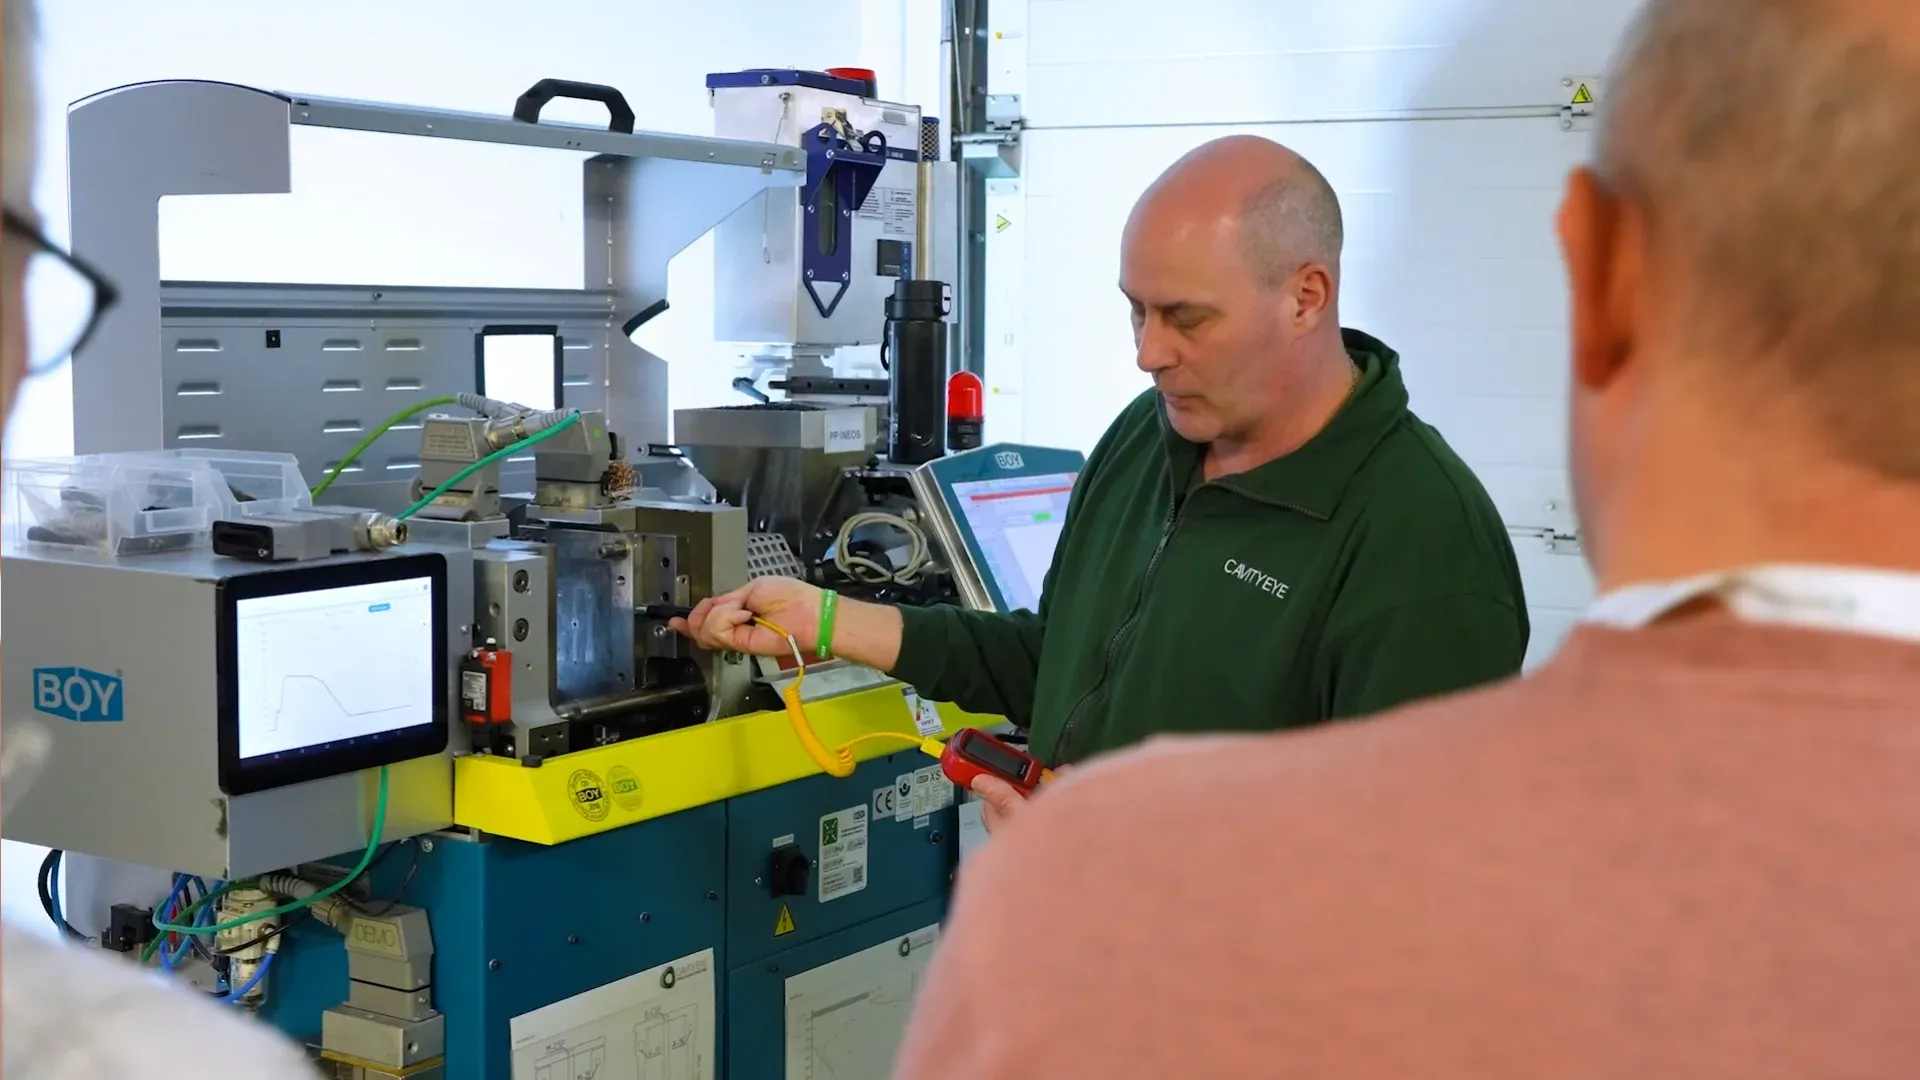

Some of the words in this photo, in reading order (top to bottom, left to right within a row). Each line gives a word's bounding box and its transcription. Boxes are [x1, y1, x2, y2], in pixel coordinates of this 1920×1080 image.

[829, 430, 838, 440] PP
[840, 429, 861, 440] INEOS
[996, 453, 1020, 468] BOY
[38, 672, 118, 716] BOY
[614, 779, 636, 793] BOY
[577, 788, 601, 802] BOY
